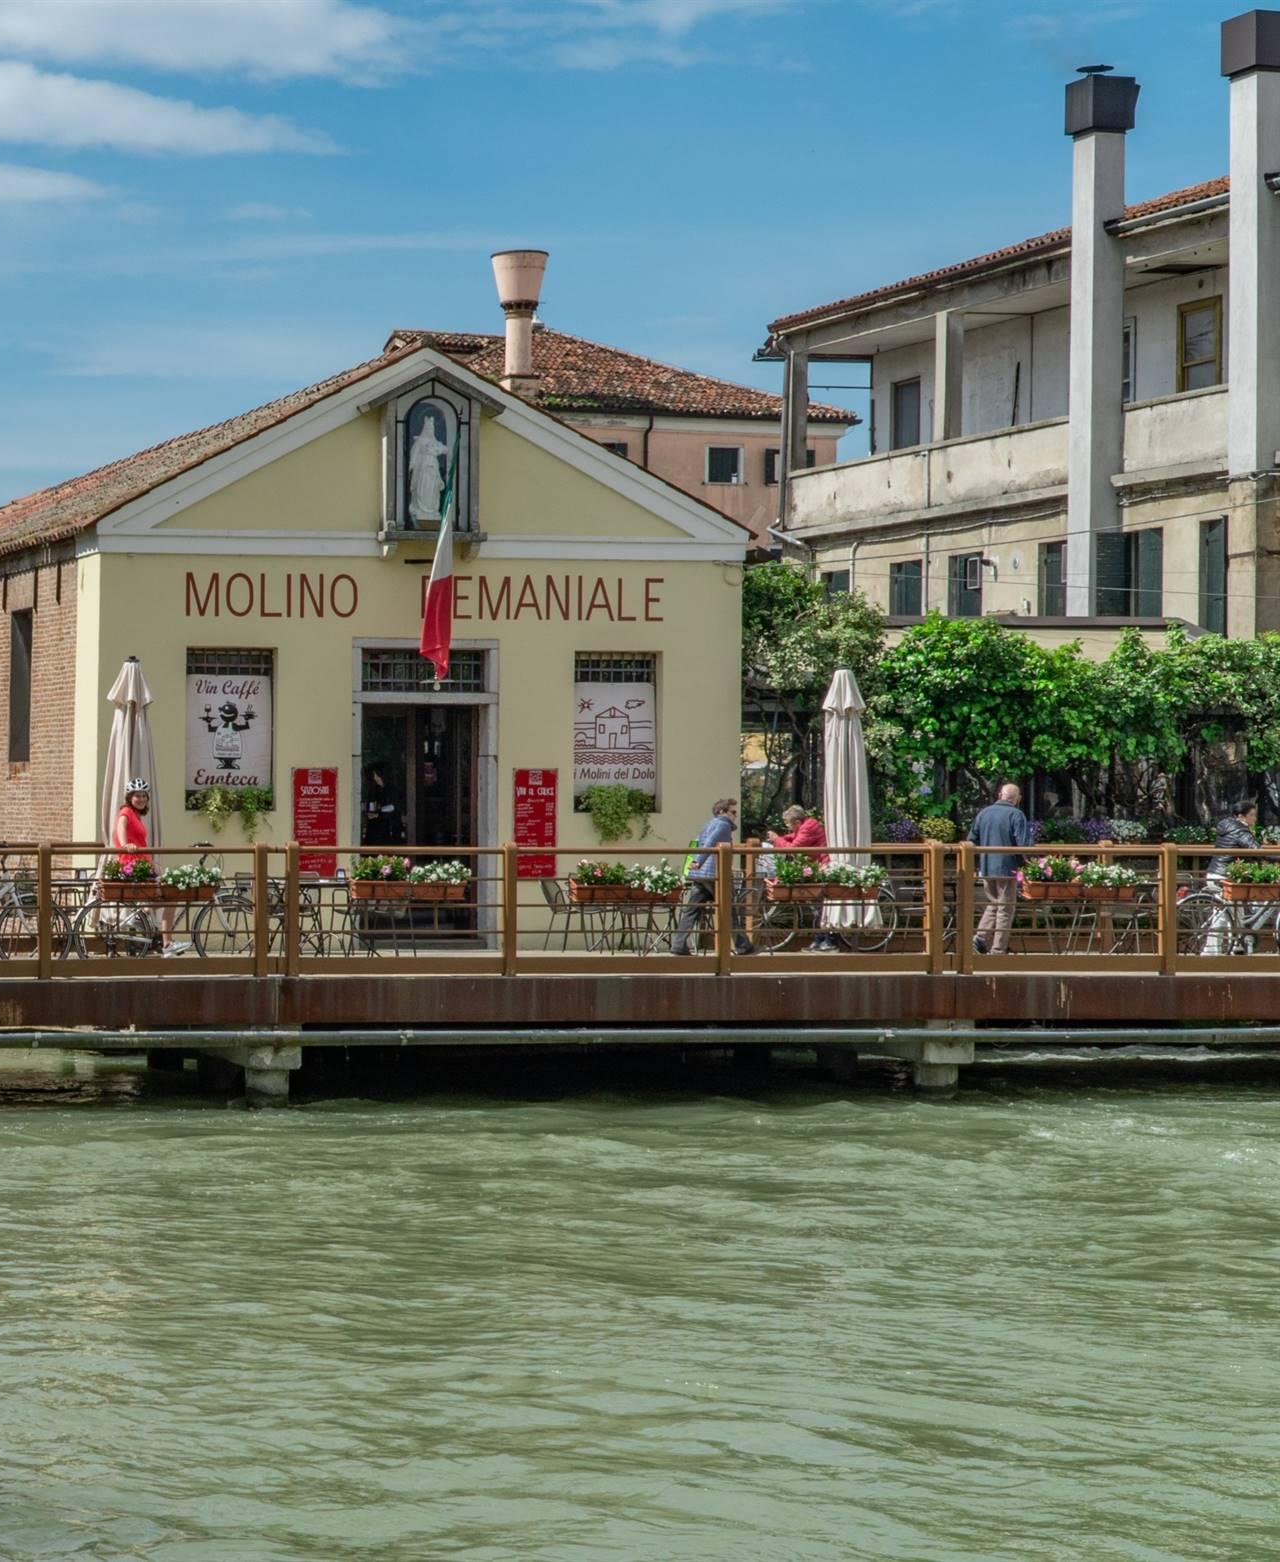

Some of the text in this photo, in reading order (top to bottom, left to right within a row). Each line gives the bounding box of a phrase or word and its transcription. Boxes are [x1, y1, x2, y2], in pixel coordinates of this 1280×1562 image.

[185, 572, 358, 618] MOLINO
[195, 680, 218, 694] Vin
[194, 769, 259, 786] Enoteca
[580, 768, 612, 780] Molini
[614, 768, 630, 780] del
[632, 768, 655, 780] Dolo
